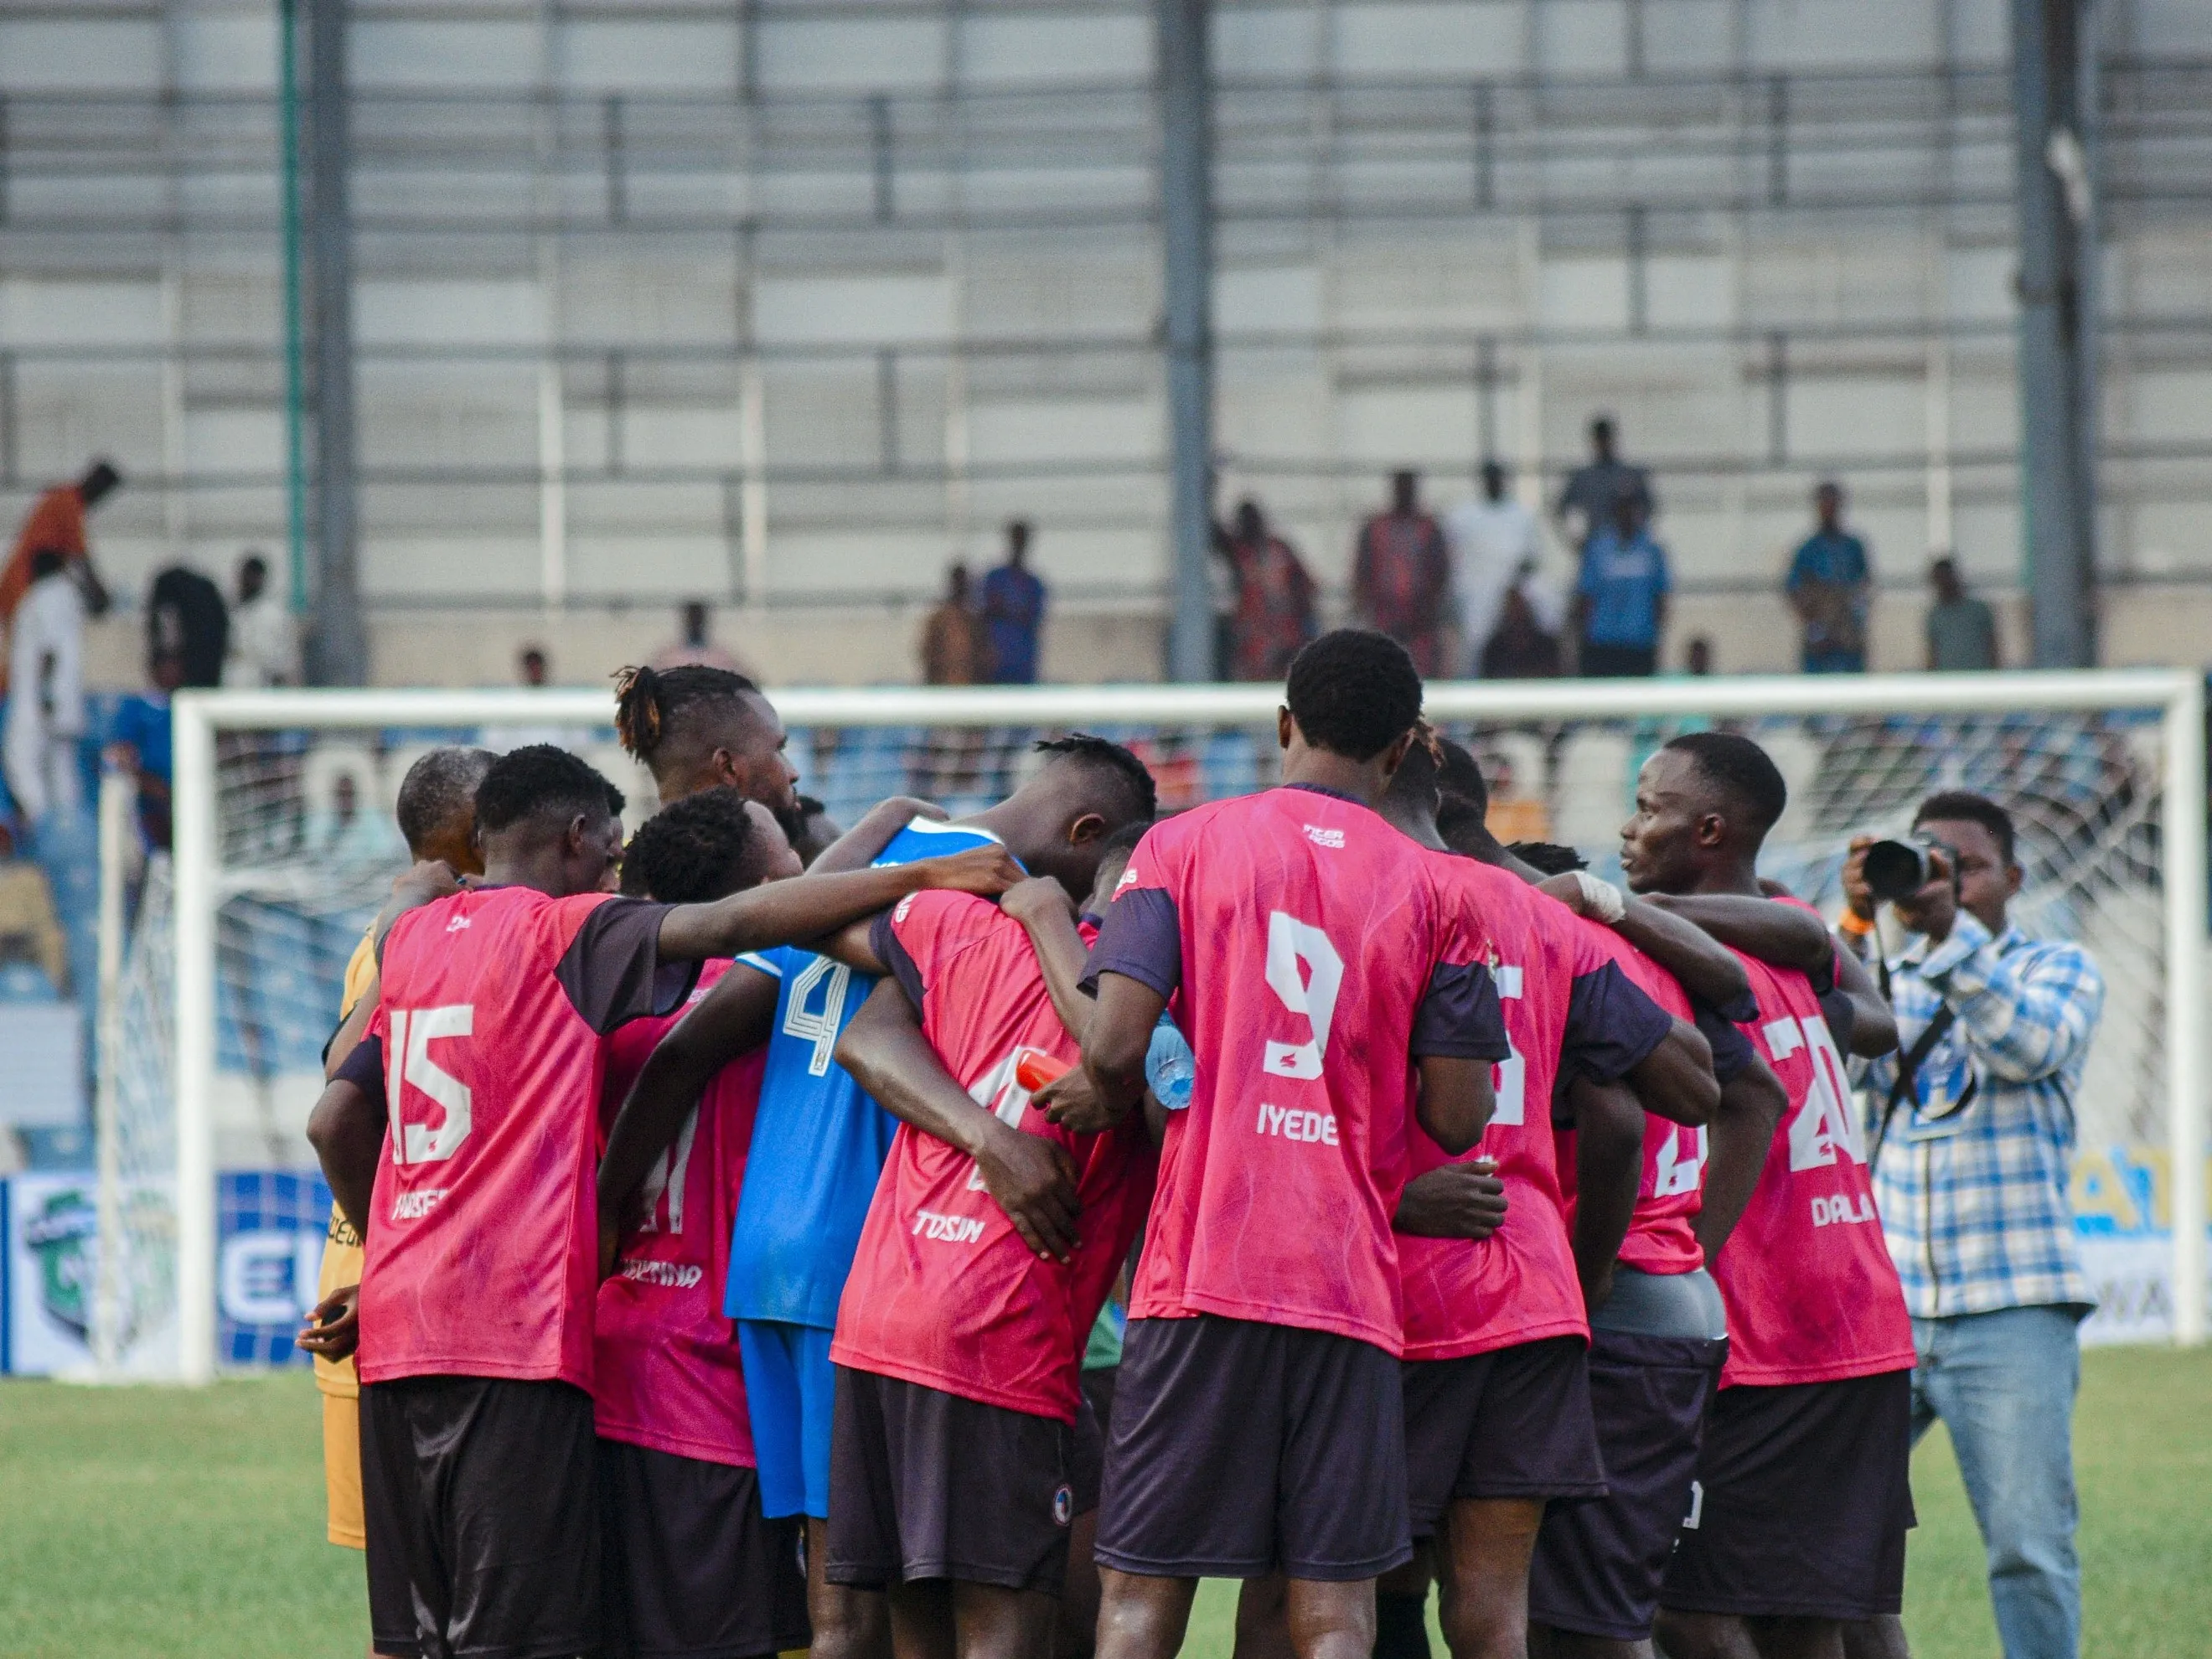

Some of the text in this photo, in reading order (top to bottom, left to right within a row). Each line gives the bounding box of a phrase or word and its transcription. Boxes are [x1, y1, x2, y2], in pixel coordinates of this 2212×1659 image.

[783, 953, 851, 1078] 4
[1264, 910, 1345, 1080] 9
[389, 1005, 474, 1165] 15
[1257, 1103, 1341, 1147] IYEDE
[1762, 1015, 1868, 1173] 20
[912, 1210, 985, 1244] TOSIN
